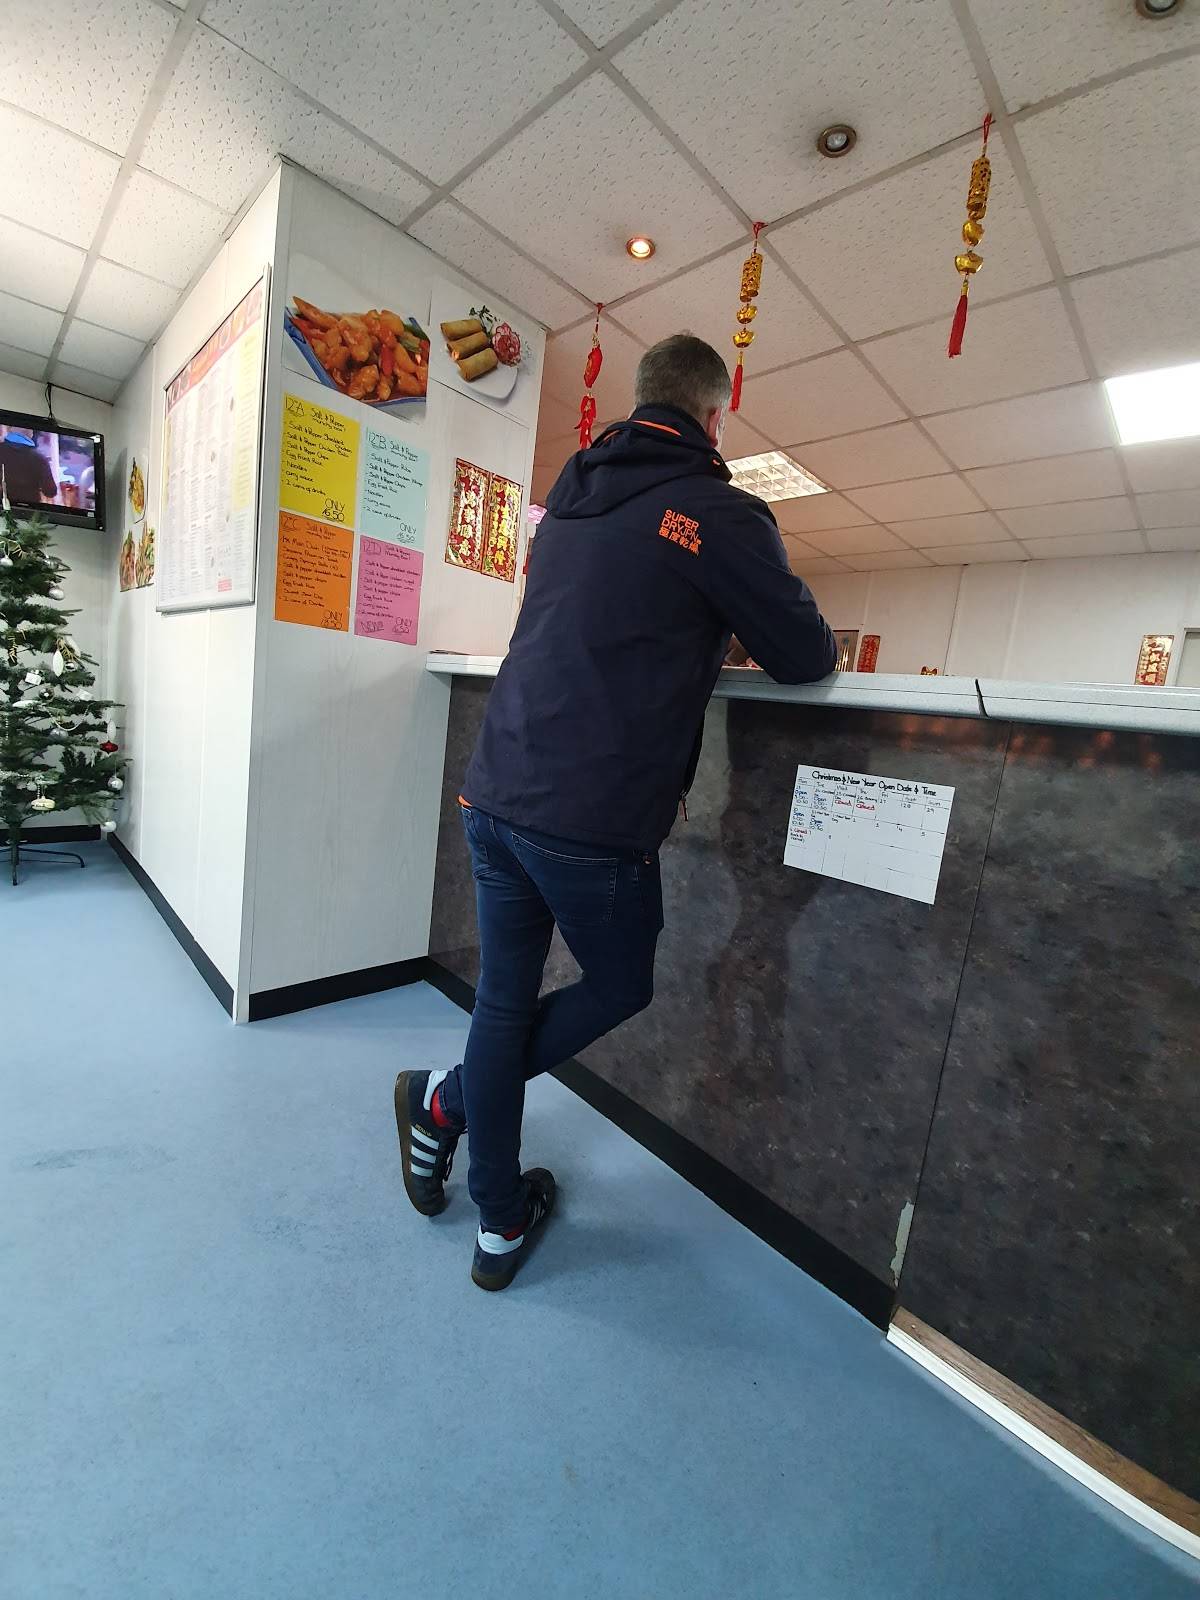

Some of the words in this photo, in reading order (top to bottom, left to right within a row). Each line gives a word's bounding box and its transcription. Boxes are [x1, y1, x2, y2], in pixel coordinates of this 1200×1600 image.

[289, 421, 303, 432] Salt
[308, 427, 322, 438] Pepper
[287, 432, 298, 441] Salt
[304, 437, 317, 447] Pepper
[390, 440, 400, 451] Salt
[286, 441, 298, 449] Salt
[304, 446, 316, 456] Pepper
[286, 450, 297, 461] Egg
[371, 453, 383, 462] Salt
[286, 460, 308, 472] Noodles
[369, 463, 378, 471] Salt
[369, 471, 379, 479] Salt
[325, 498, 346, 512] ONLY
[661, 517, 684, 533] DRY
[664, 509, 700, 532] SUPER
[400, 522, 417, 535] ONLY
[323, 609, 343, 622] ONLY
[396, 616, 412, 627] ONLY
[811, 770, 841, 783] Christmas
[847, 776, 861, 786] New
[861, 778, 877, 788] Year
[878, 780, 896, 792] Open
[896, 782, 913, 793] Date
[922, 786, 937, 797] Time
